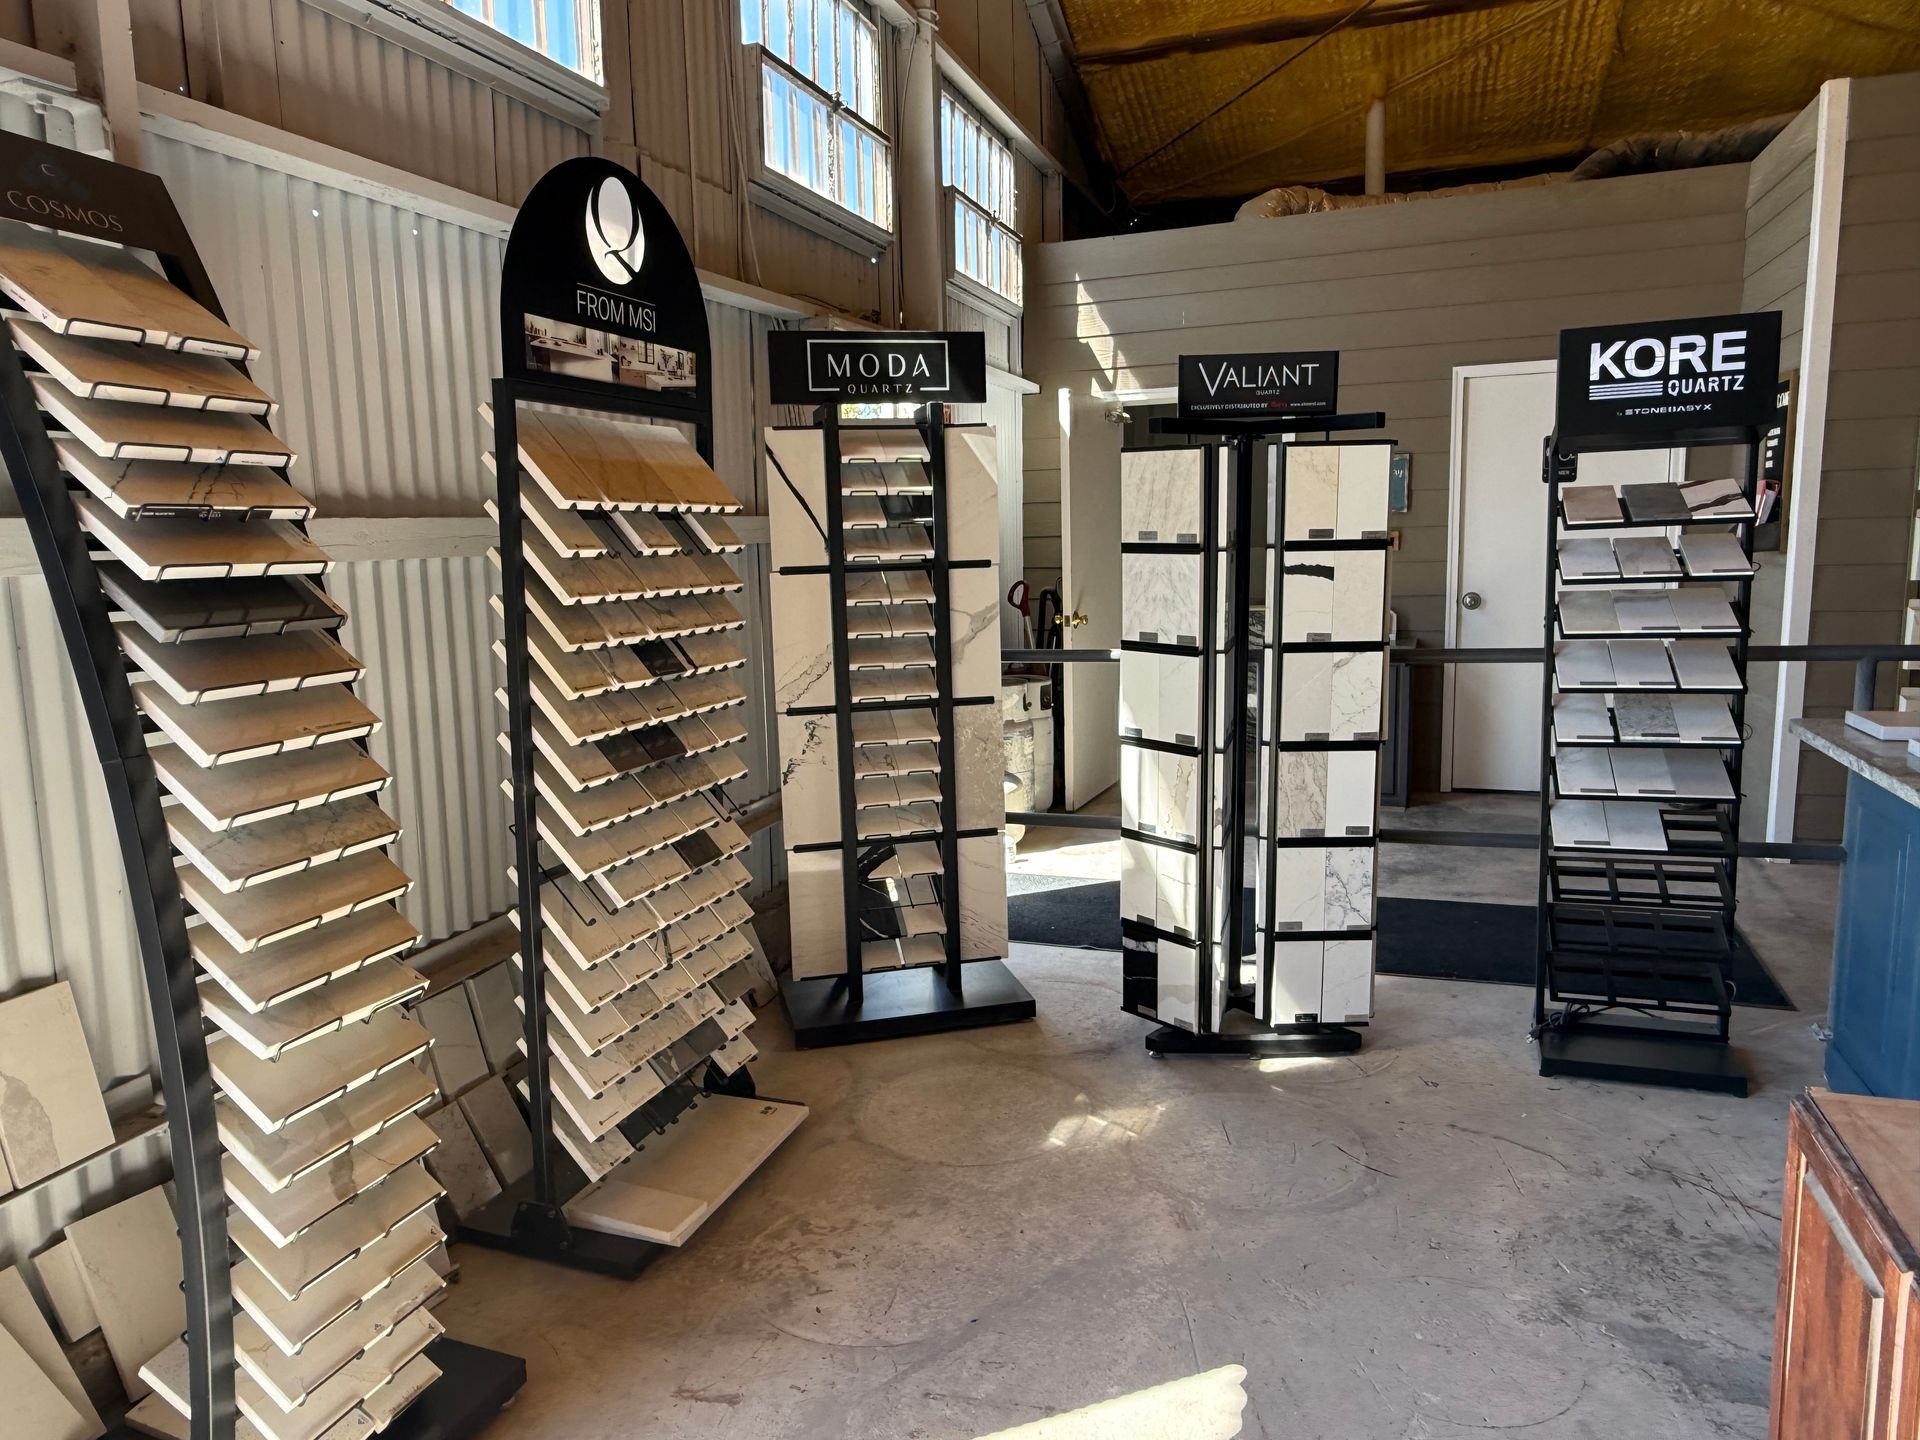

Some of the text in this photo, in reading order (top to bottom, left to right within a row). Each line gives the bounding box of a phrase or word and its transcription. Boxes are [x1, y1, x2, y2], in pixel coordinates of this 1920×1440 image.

[7, 190, 123, 232] COSMOS
[577, 290, 656, 333] FROM MSI
[827, 353, 931, 378] MODA
[1589, 330, 1747, 381] KORE
[847, 383, 913, 394] QUARTZ
[1198, 361, 1319, 397] VALIANT
[1668, 375, 1744, 396] QUARTZ
[1225, 402, 1260, 410] DISTRIBUTED
